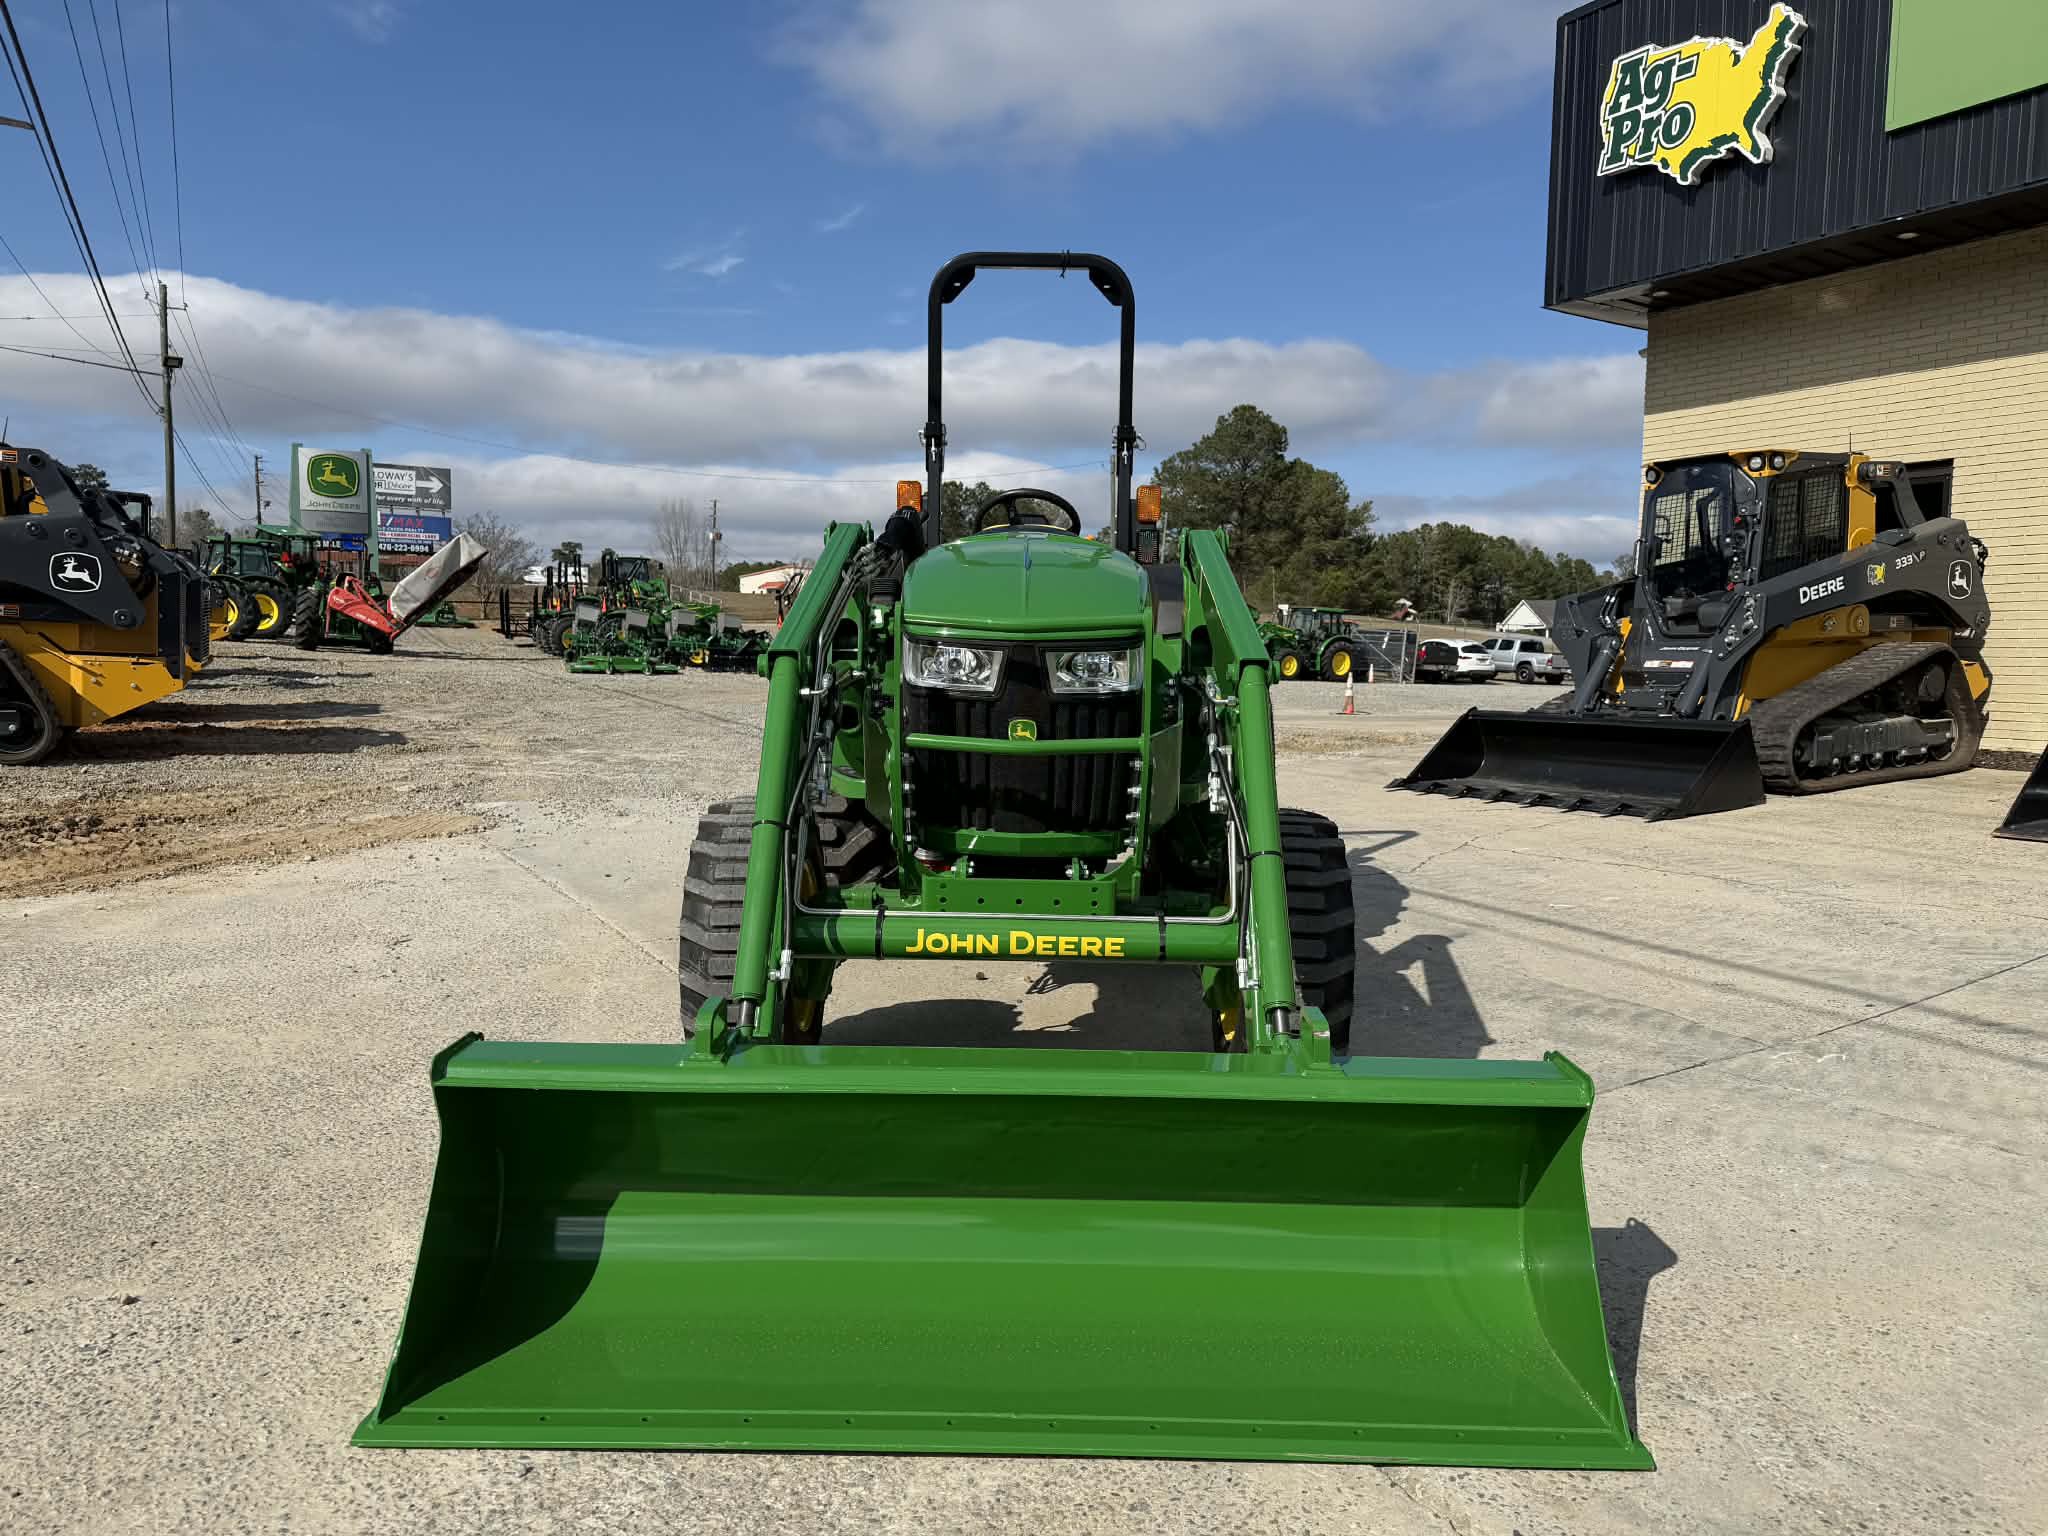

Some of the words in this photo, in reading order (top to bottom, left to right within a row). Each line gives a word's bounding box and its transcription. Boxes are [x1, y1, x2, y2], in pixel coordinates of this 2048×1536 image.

[1607, 50, 1699, 120] Ag-
[1598, 102, 1696, 174] Pro
[1800, 575, 1846, 605] DEERE
[905, 928, 999, 954] JOHN
[1009, 930, 1125, 957] DEERE
